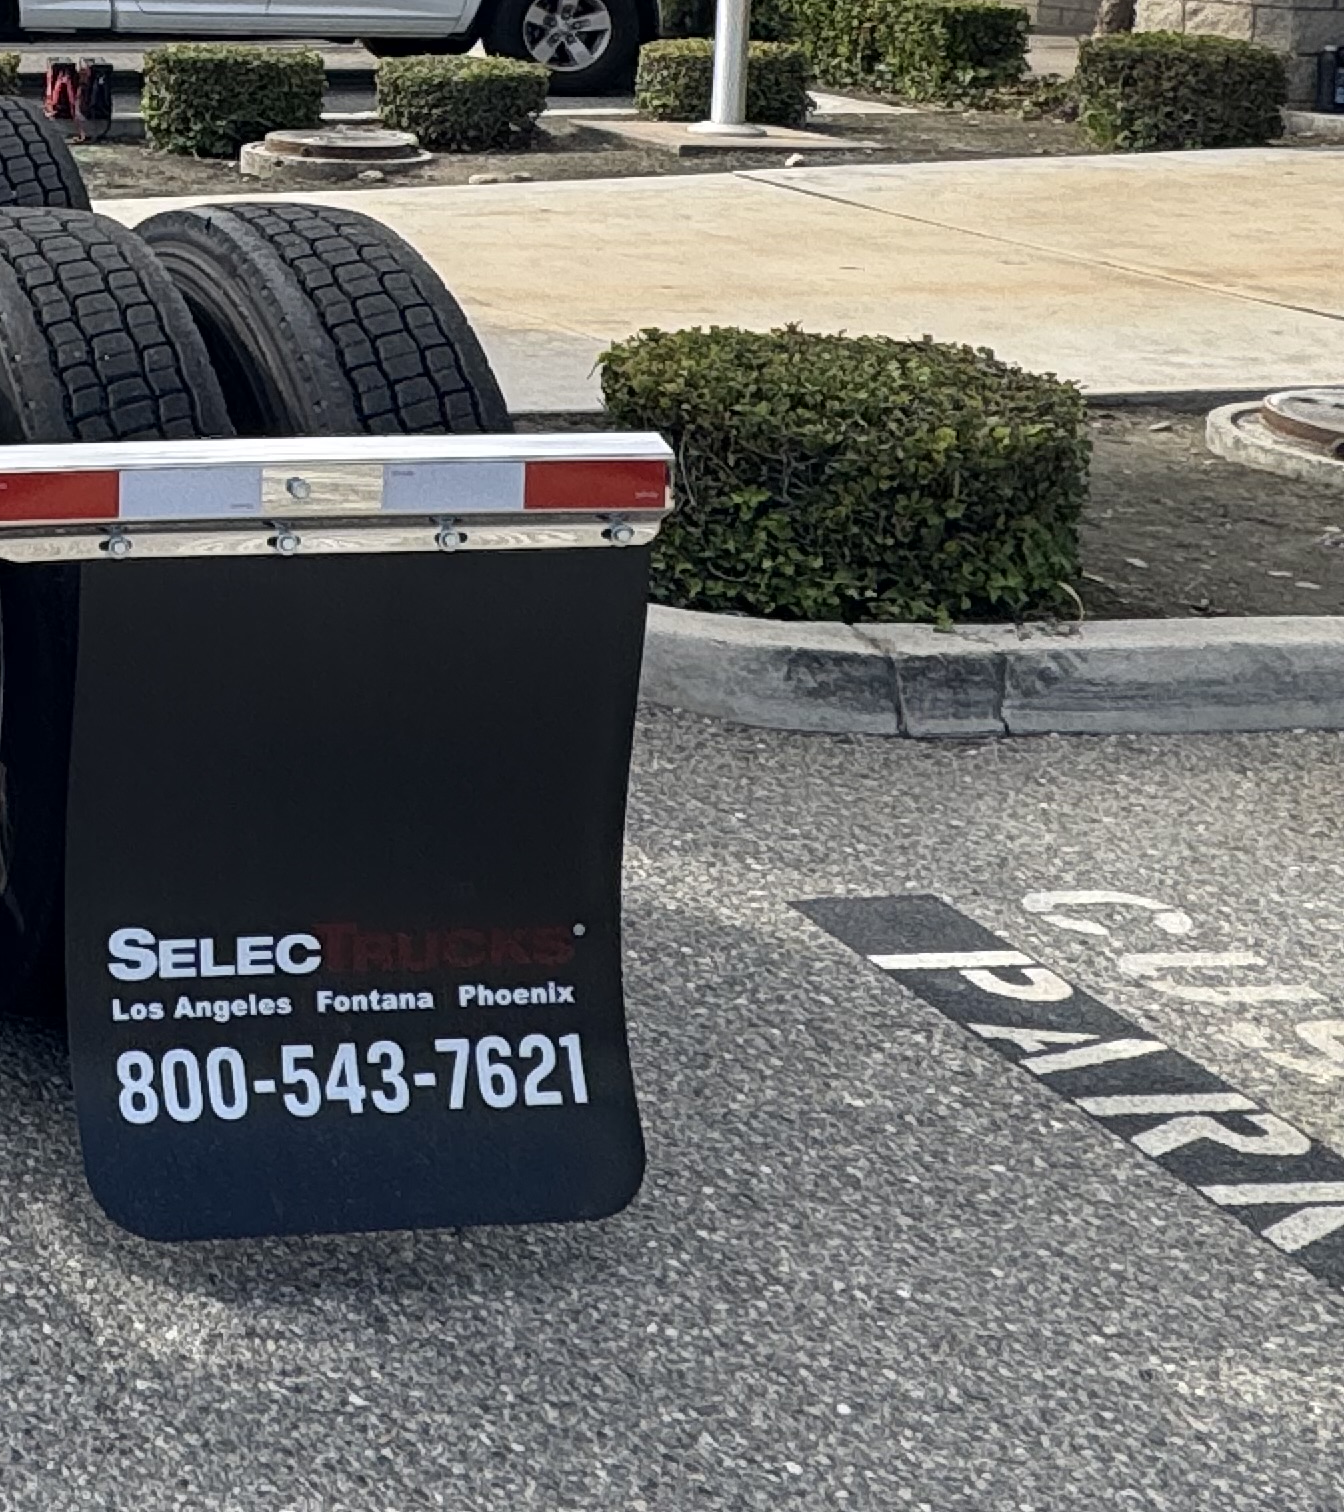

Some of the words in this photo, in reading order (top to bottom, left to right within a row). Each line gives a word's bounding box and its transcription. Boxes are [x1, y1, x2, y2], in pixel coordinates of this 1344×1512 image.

[111, 998, 165, 1022] Los
[173, 993, 293, 1024] Angeles
[316, 989, 435, 1014] Fontana
[458, 981, 576, 1008] Phoenix
[116, 1032, 589, 1125] 800-543-7621
